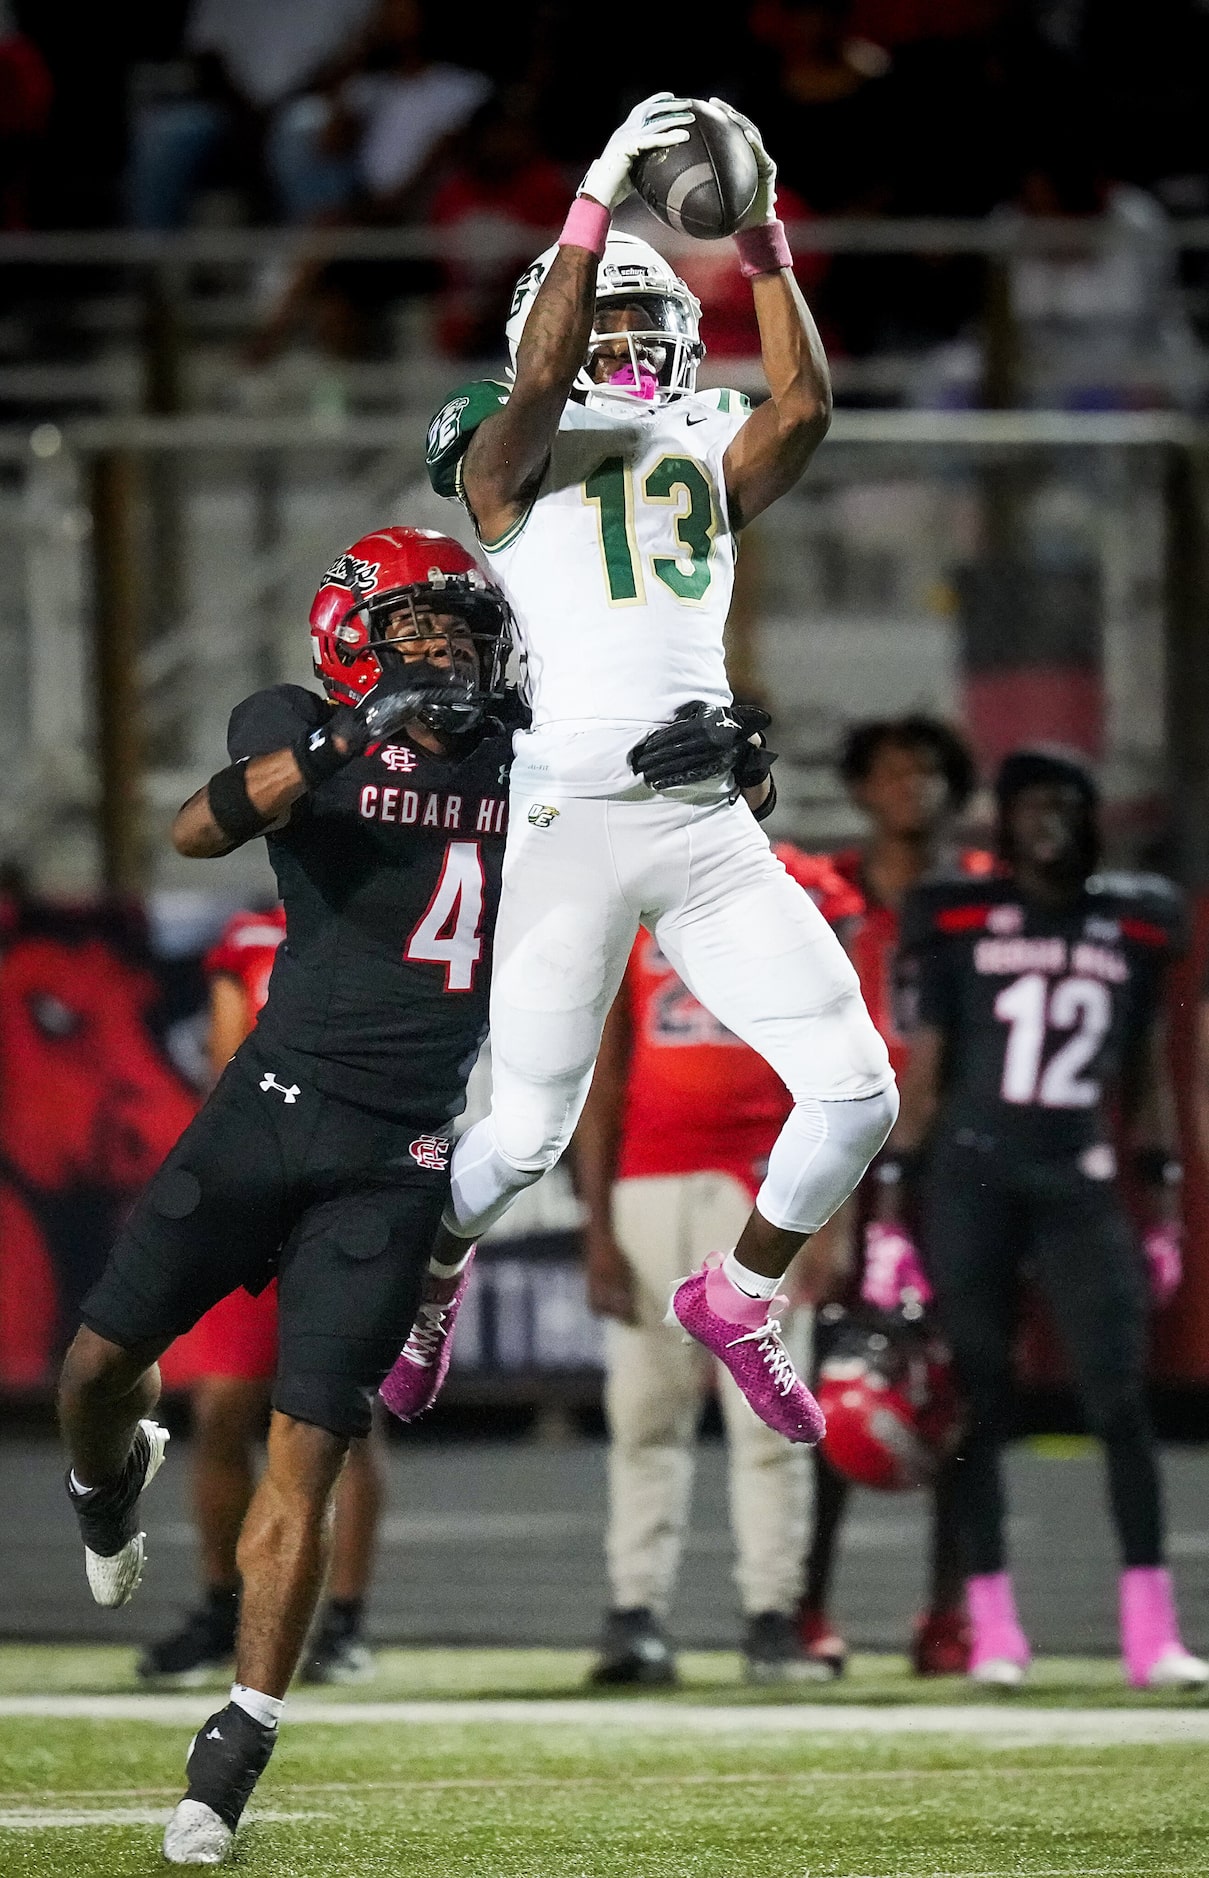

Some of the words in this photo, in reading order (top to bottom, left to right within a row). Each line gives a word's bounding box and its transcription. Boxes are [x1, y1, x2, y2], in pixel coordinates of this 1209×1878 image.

[581, 454, 716, 609] 13
[359, 784, 462, 830] CEDAR
[403, 838, 486, 992] 4
[993, 973, 1112, 1107] 12
